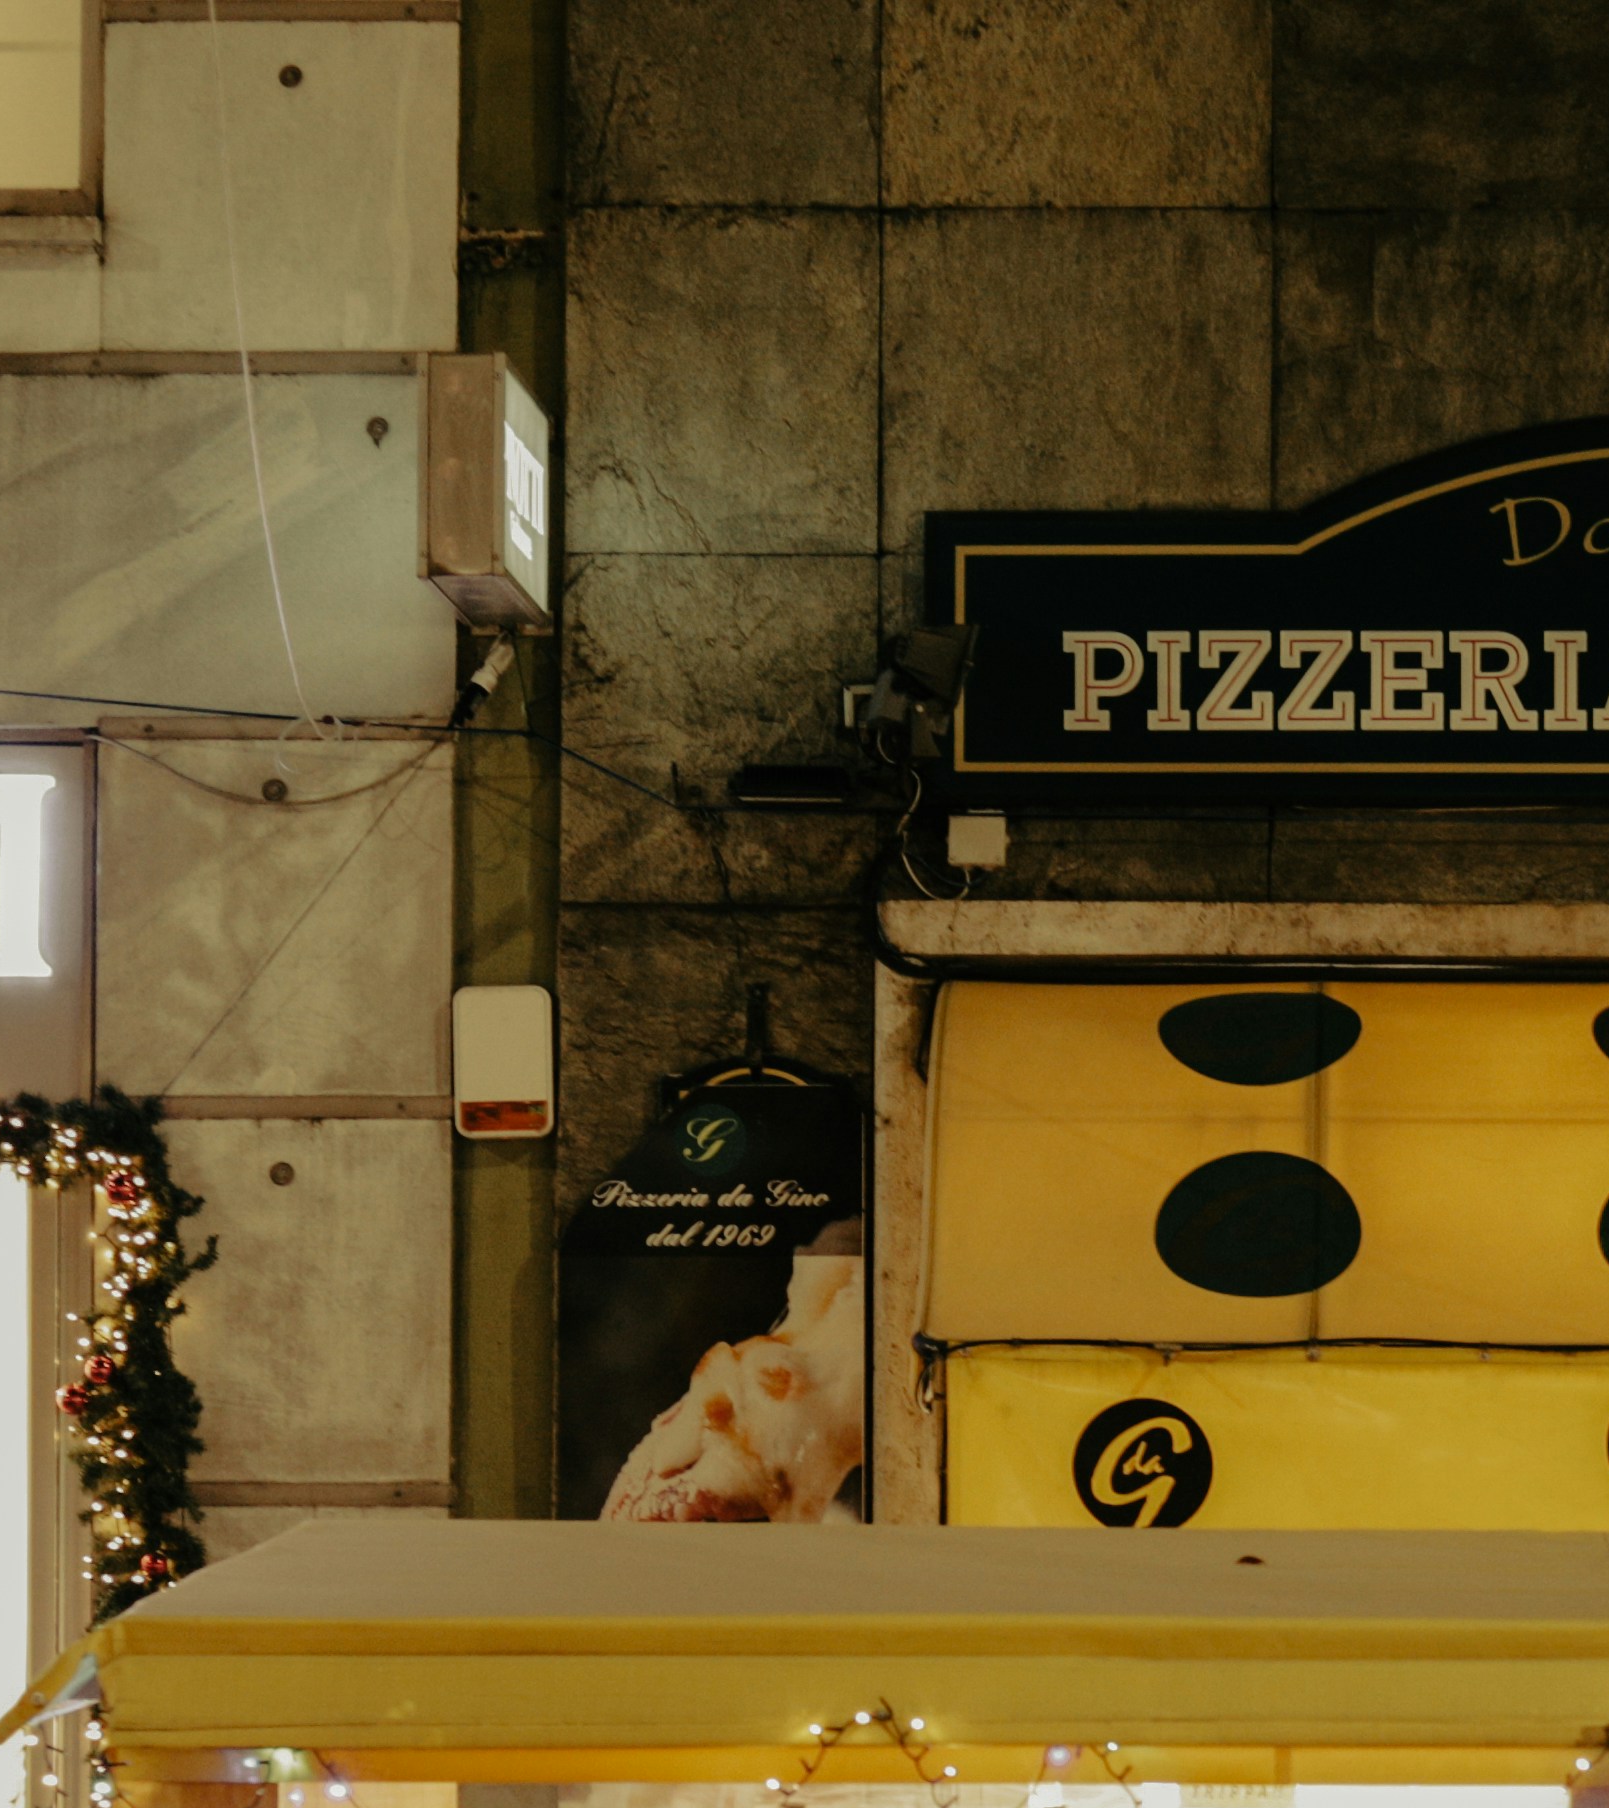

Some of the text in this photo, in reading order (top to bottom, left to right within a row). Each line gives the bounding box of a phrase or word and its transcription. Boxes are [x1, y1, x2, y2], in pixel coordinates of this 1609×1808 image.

[592, 1179, 830, 1208] Pizzeria da Gino
[646, 1220, 776, 1248] dal 1969
[1122, 1440, 1165, 1476] da
